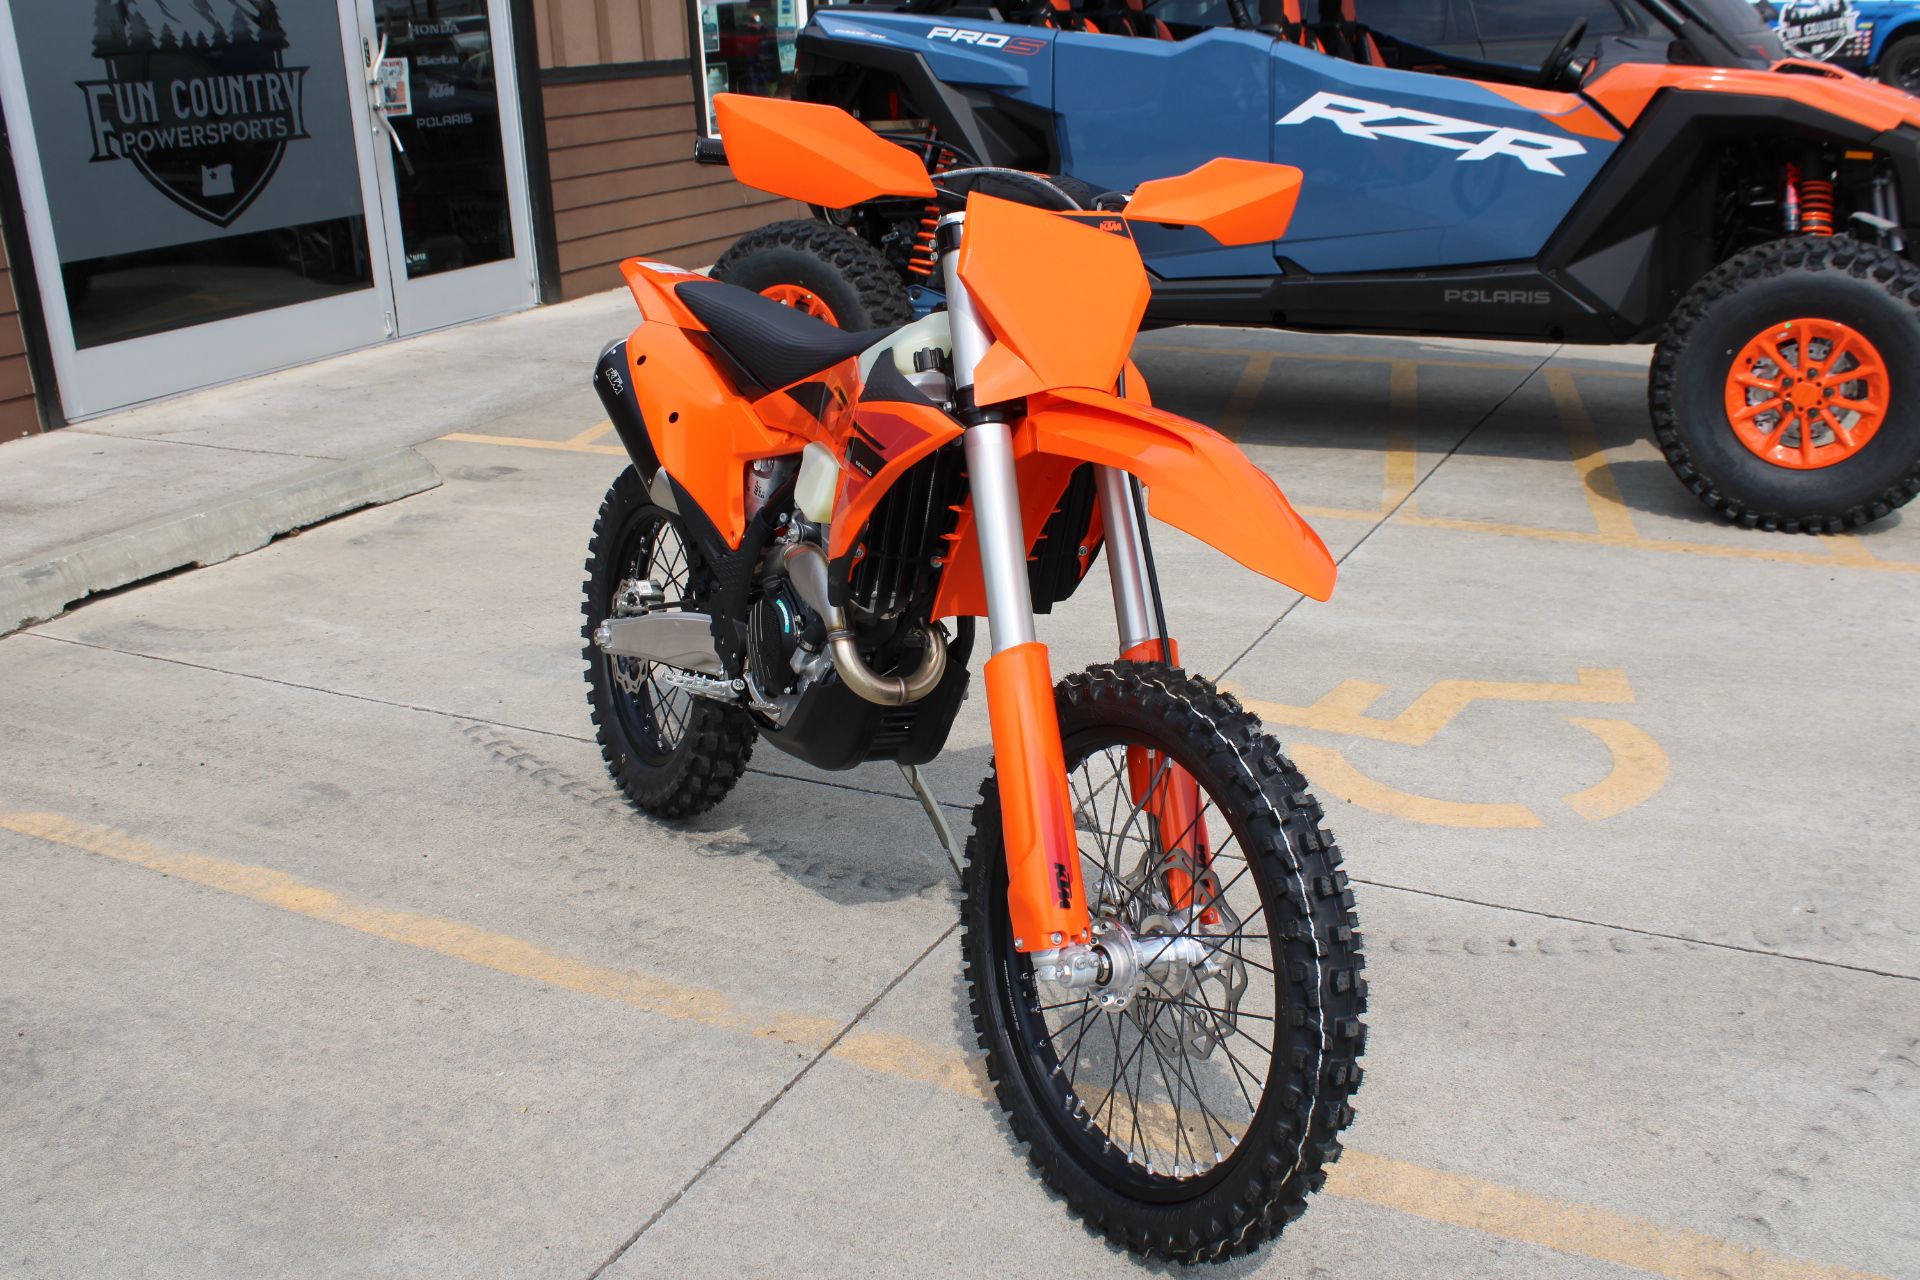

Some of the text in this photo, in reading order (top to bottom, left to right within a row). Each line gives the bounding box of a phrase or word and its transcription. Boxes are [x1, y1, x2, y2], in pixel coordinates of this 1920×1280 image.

[410, 23, 460, 35] HONDA
[416, 56, 460, 66] Beta
[427, 83, 456, 98] KTM
[86, 70, 304, 158] FUN COUNTRY
[416, 113, 473, 129] POLARIS
[121, 117, 288, 154] POWERSPORTS
[1275, 91, 1588, 176] RZR
[1099, 220, 1123, 232] KTM
[1444, 289, 1550, 305] POLARIS
[605, 367, 624, 395] KTM
[1054, 862, 1072, 909] KTM
